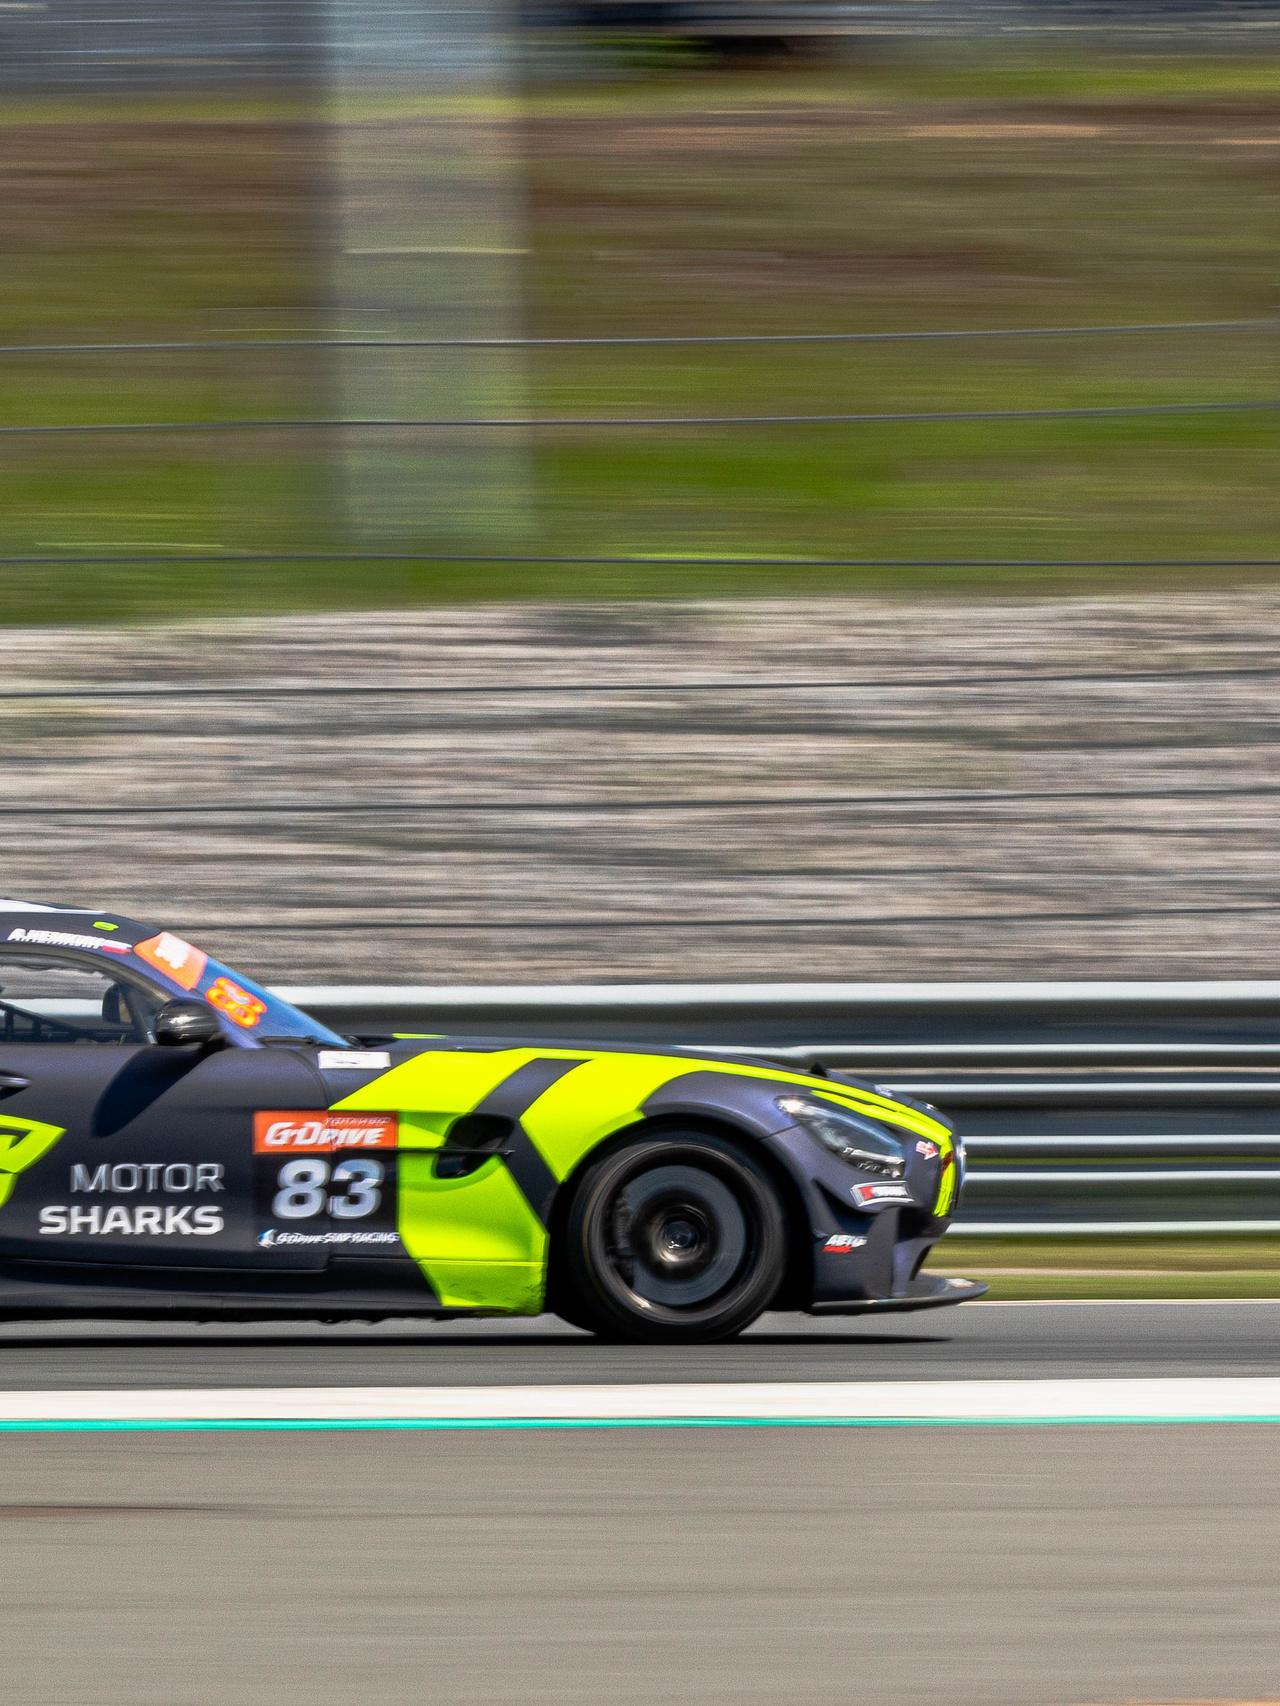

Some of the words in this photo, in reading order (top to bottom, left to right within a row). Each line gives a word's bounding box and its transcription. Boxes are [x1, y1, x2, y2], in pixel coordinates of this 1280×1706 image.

[70, 1163, 225, 1193] MOTOR
[272, 1159, 385, 1220] 83
[39, 1205, 224, 1236] SHARKS
